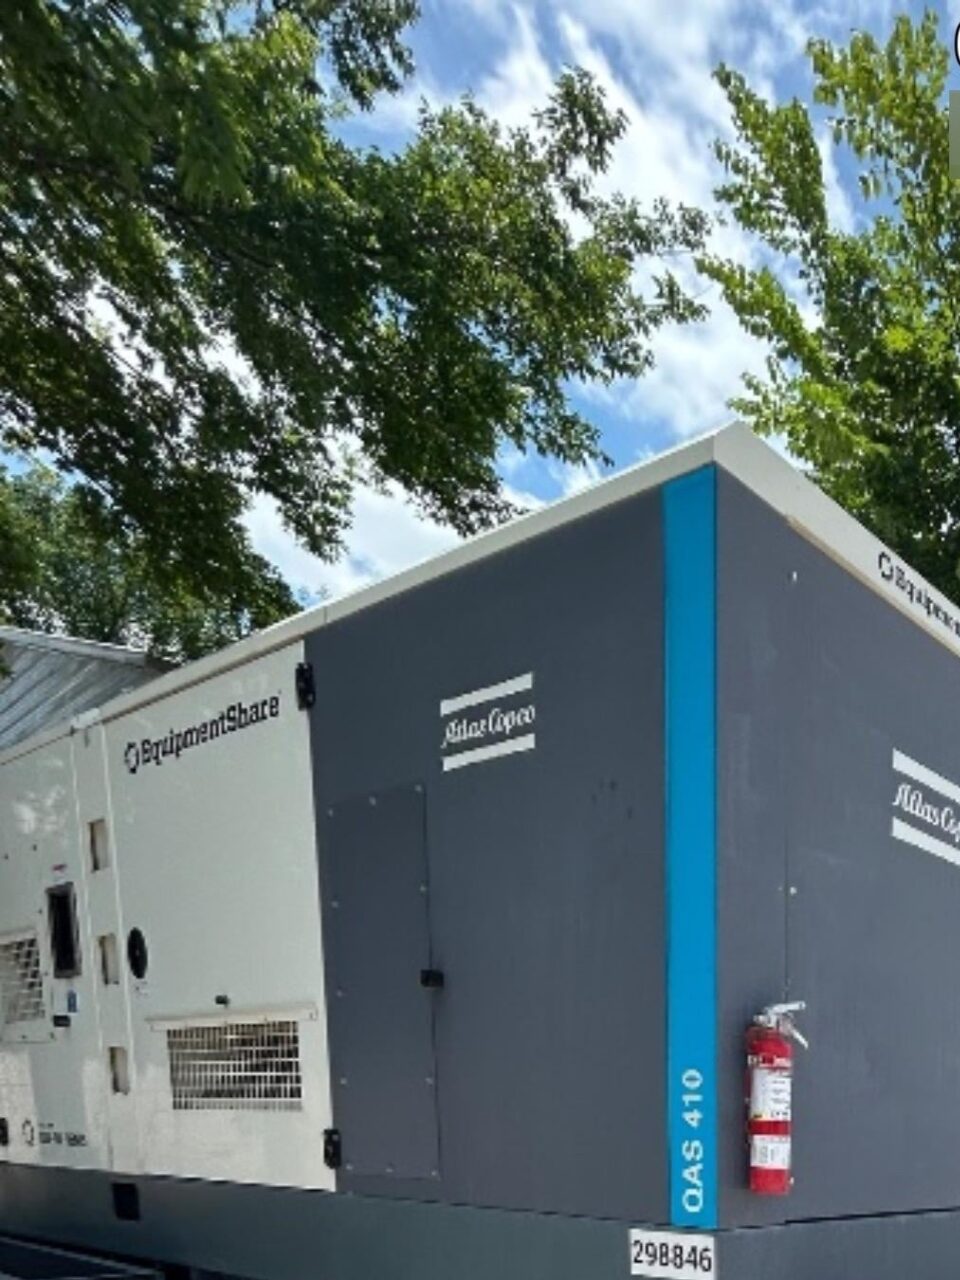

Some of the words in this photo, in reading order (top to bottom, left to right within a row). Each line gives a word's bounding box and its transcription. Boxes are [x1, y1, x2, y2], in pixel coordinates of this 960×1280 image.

[141, 695, 281, 766] EquipmentShare
[440, 718, 487, 749] Atlas
[488, 704, 536, 735] Copco
[892, 782, 940, 826] Atlas
[681, 1068, 704, 1129] 410
[681, 1139, 704, 1214] QAS
[632, 1239, 713, 1273] 298846
